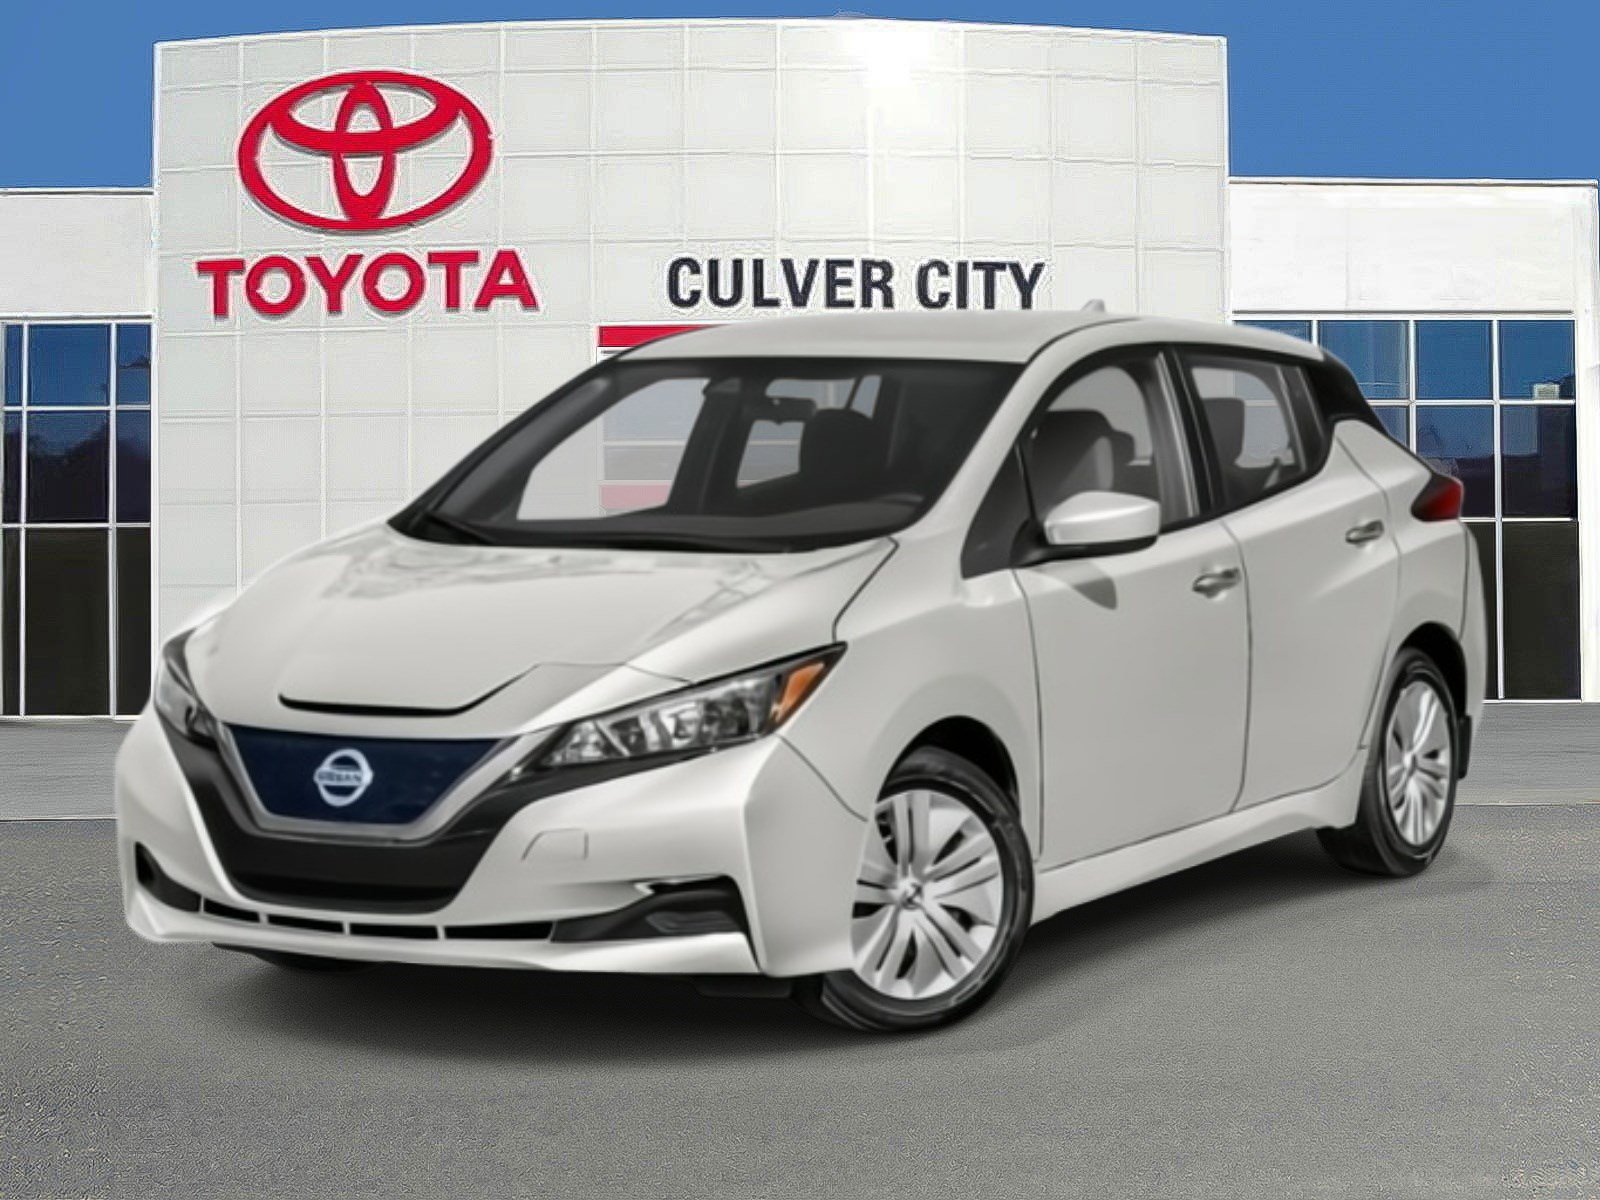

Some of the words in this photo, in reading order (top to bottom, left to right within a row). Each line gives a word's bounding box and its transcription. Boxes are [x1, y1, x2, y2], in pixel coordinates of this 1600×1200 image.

[196, 249, 539, 317] TOYOTA
[667, 257, 896, 309] CULVER
[915, 260, 1046, 310] CITY
